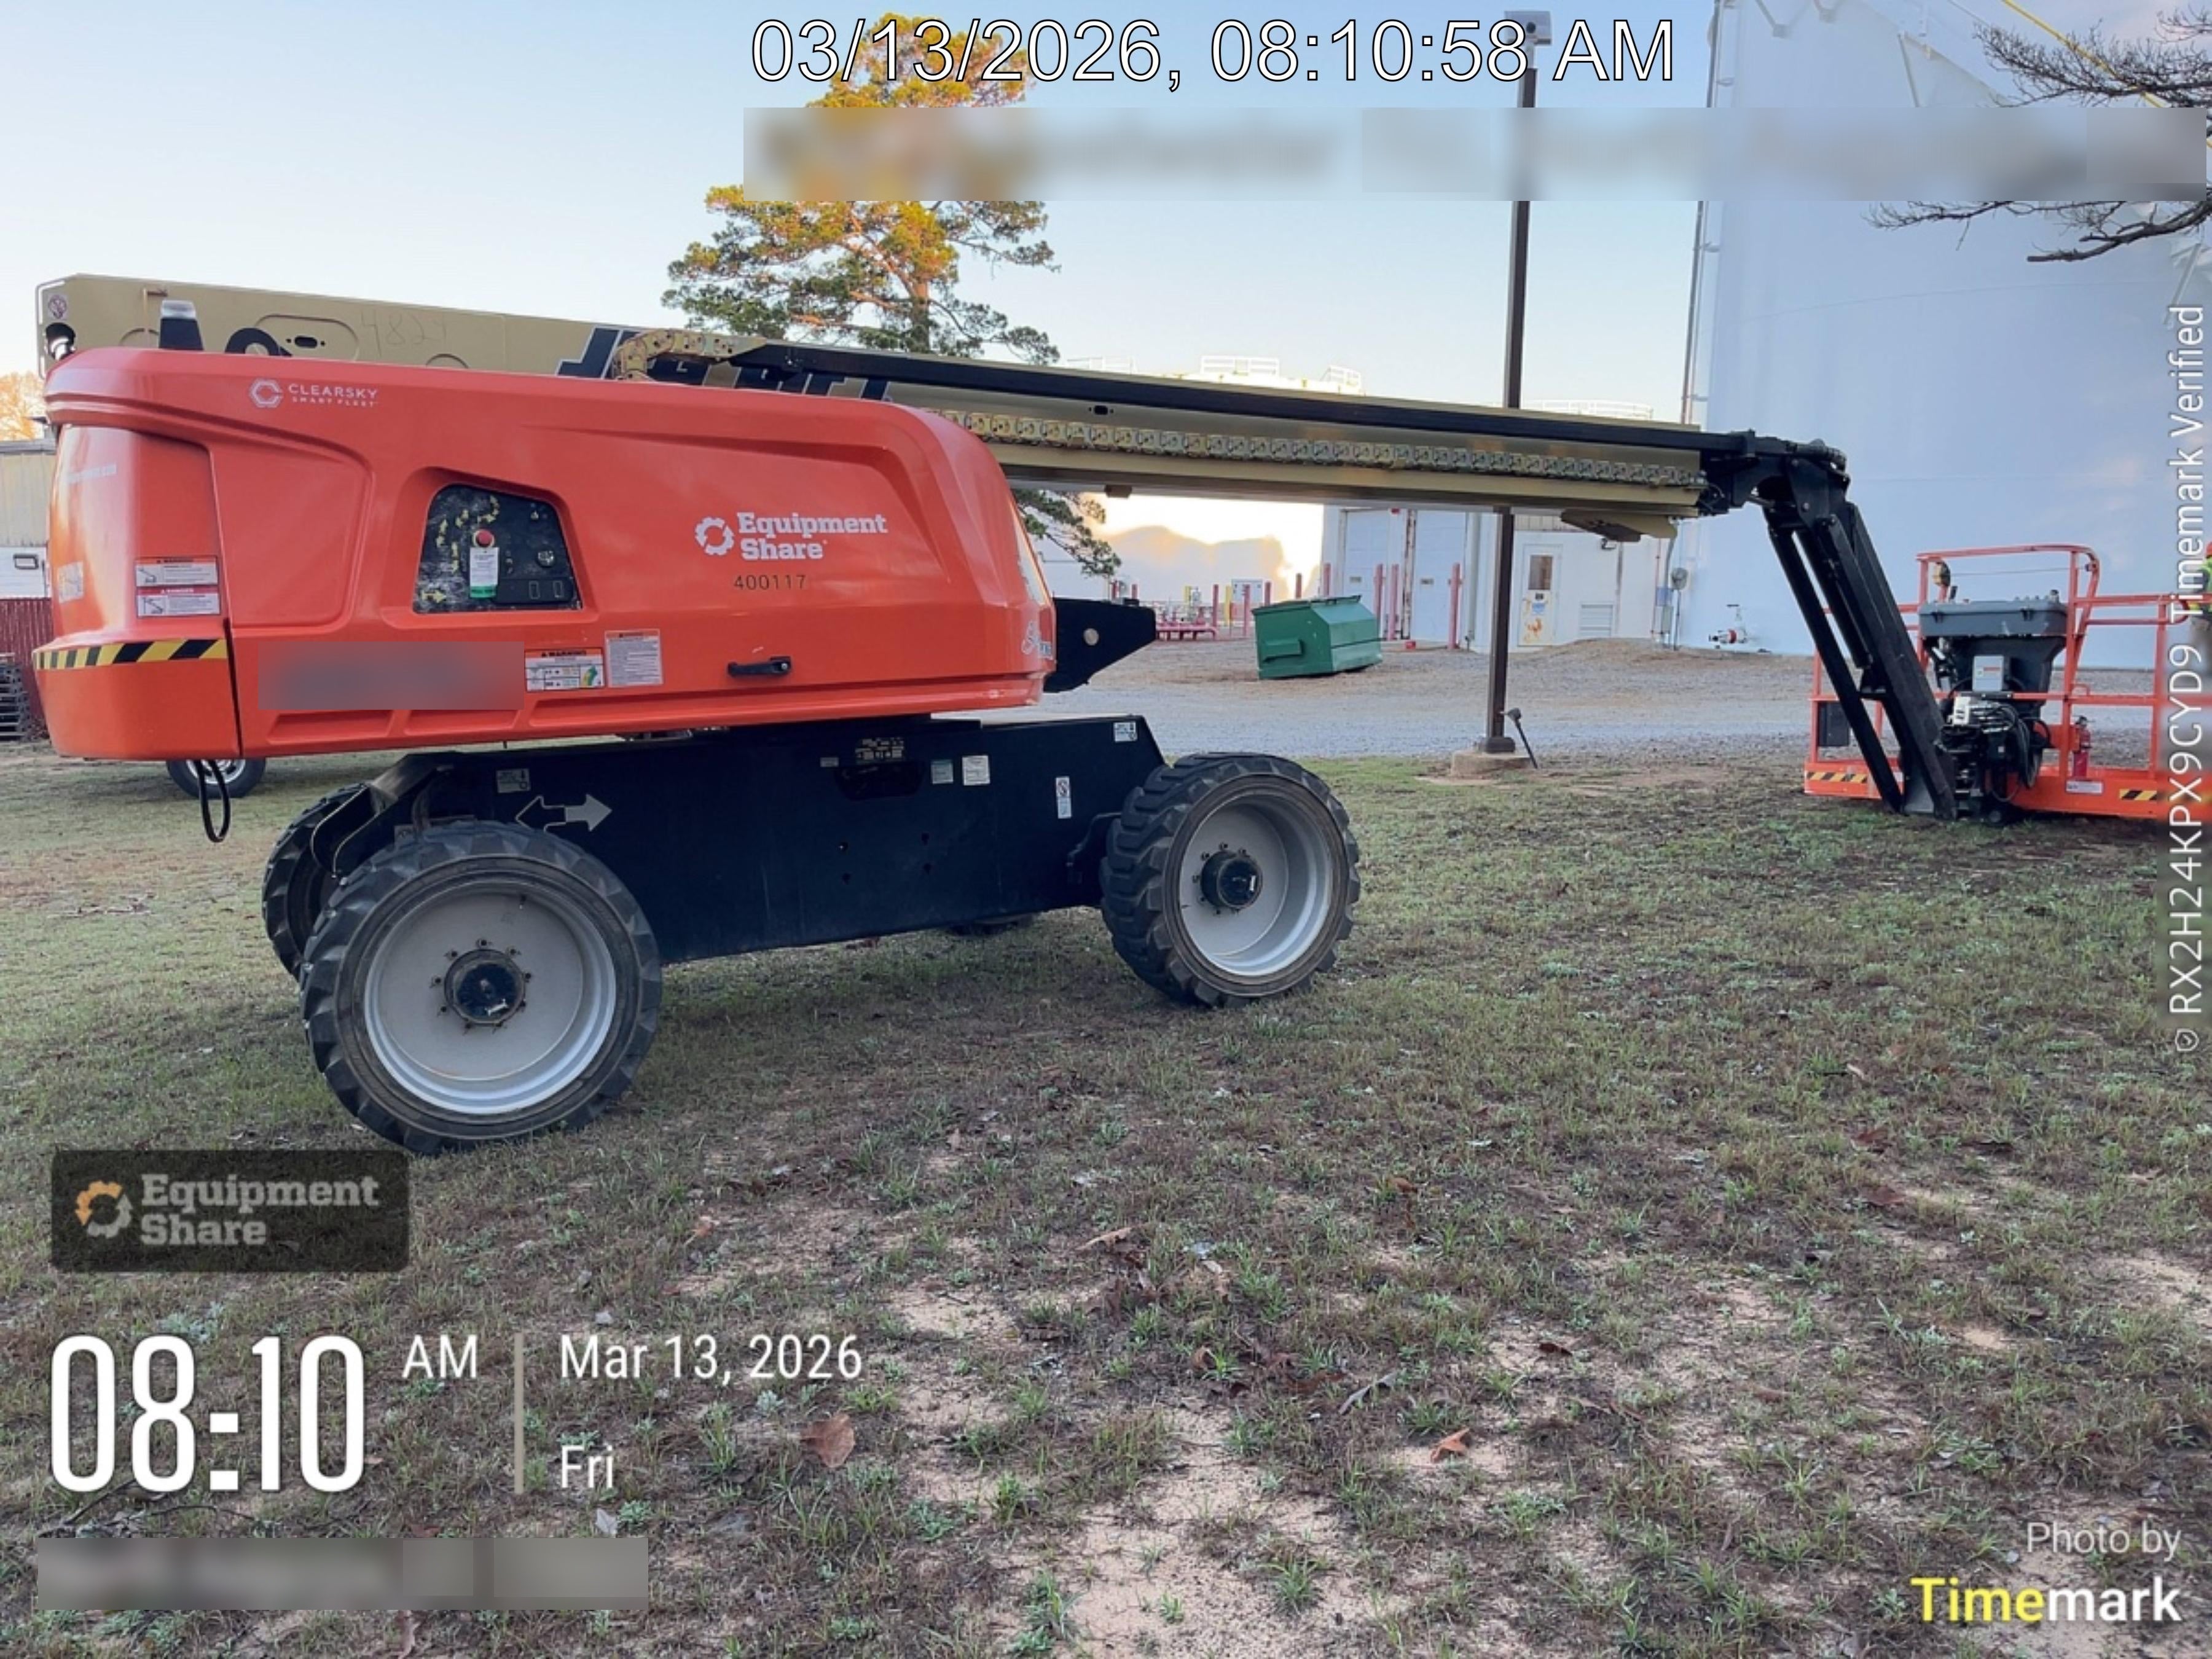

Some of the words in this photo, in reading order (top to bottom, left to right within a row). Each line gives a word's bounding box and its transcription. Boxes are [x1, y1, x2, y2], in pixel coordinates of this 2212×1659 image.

[288, 383, 377, 398] CLEARSKY
[737, 512, 888, 538] Equipment
[740, 538, 823, 560] Share
[734, 575, 807, 590] 400117
